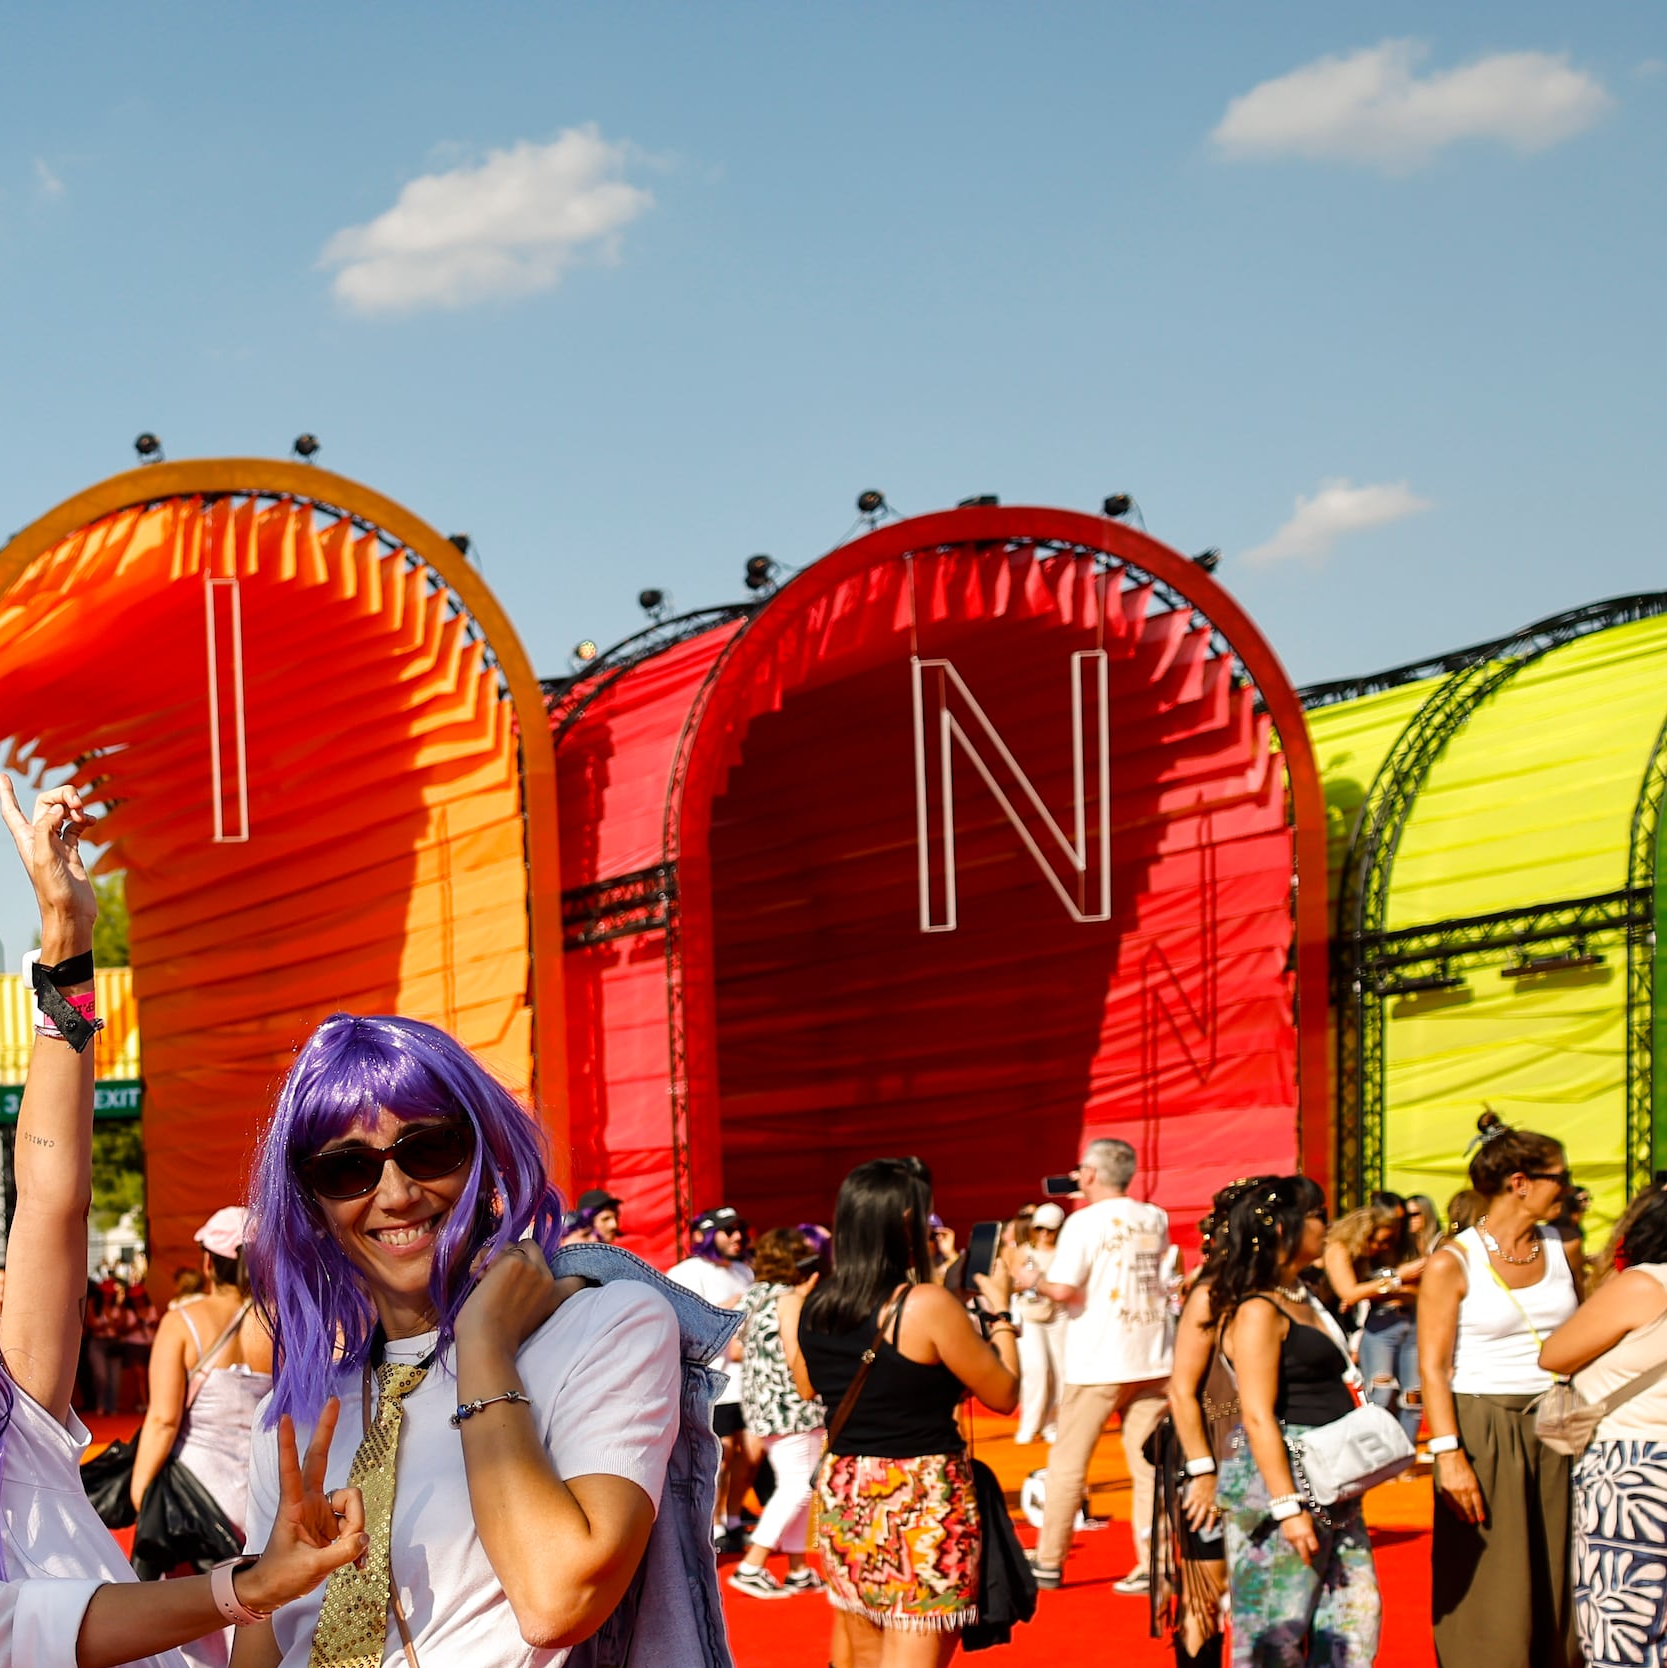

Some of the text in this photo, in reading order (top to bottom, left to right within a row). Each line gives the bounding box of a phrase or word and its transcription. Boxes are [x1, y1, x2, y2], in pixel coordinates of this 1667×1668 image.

[204, 576, 251, 844] I
[910, 648, 1113, 934] N
[24, 1131, 56, 1148] CAMILO
